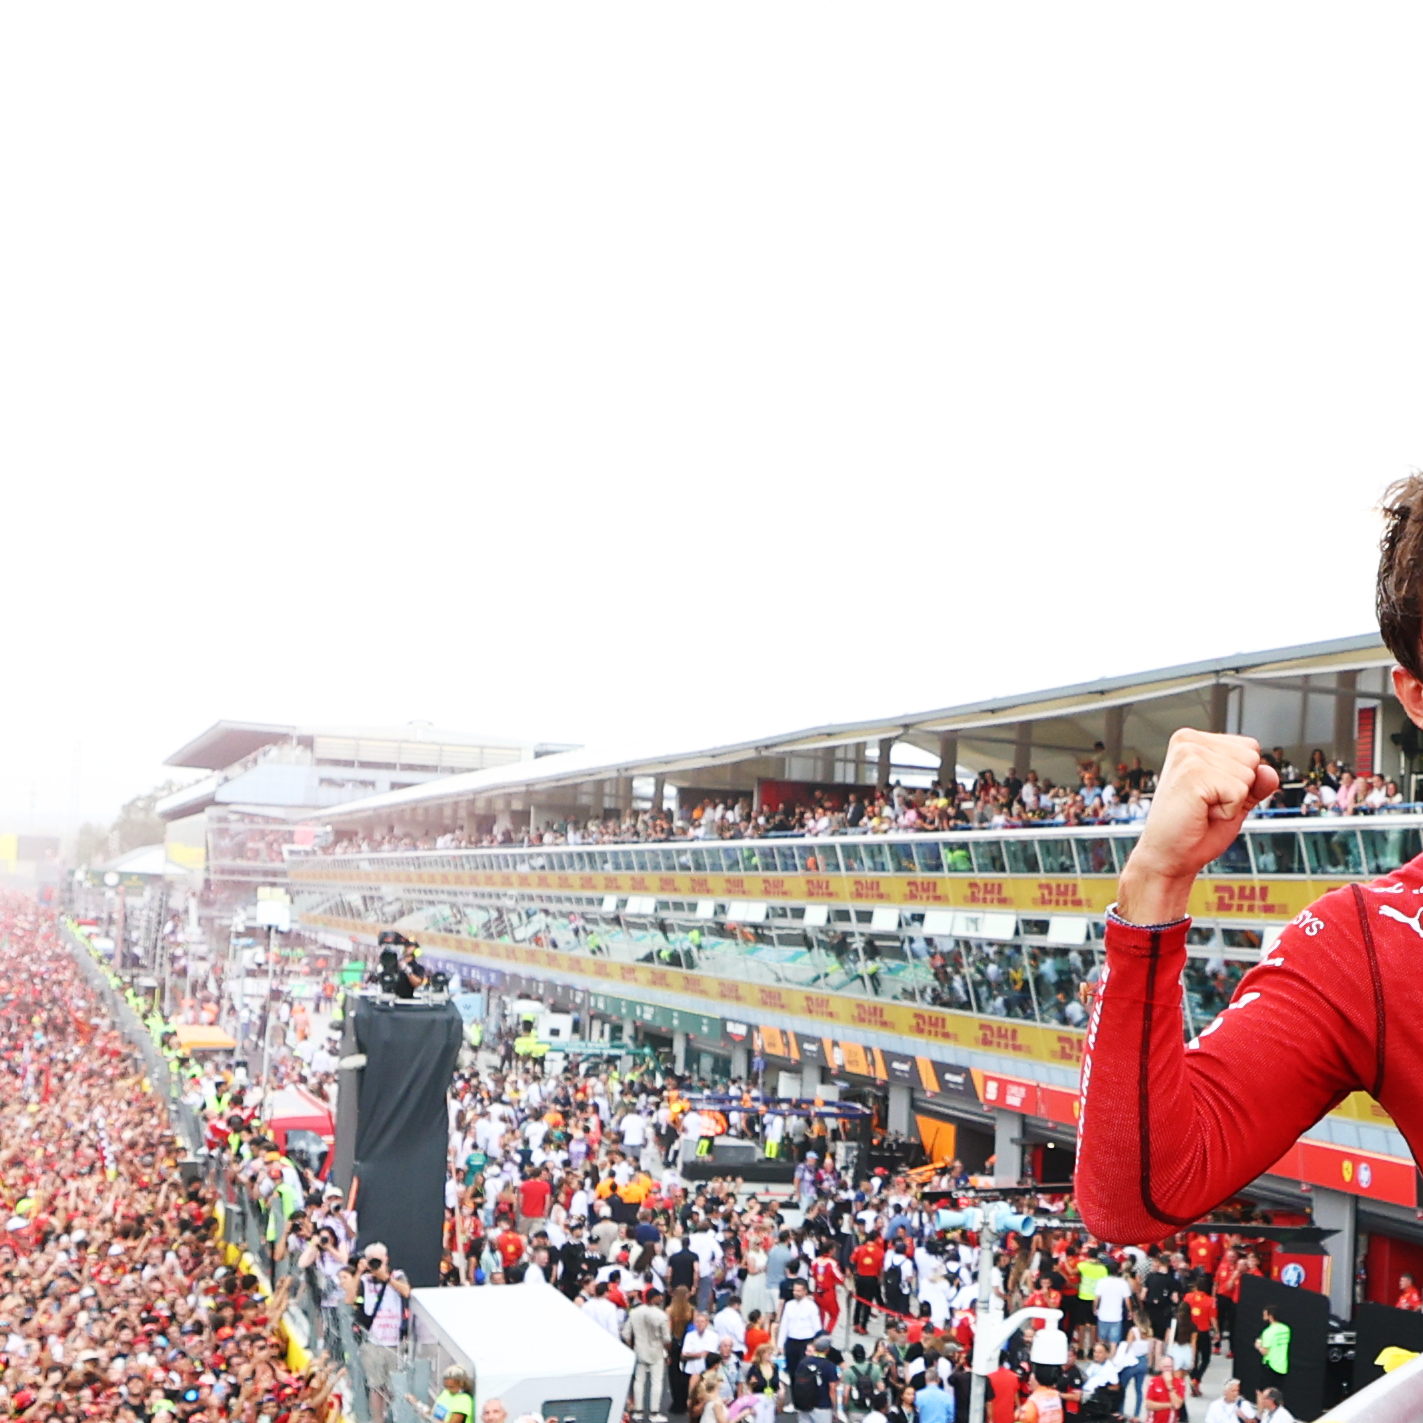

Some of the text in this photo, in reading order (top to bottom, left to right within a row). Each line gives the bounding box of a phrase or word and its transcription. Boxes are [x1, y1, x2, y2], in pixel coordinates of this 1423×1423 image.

[906, 881, 943, 901] DHL
[968, 882, 1011, 904] DHL
[1037, 883, 1085, 907] DHL
[1213, 884, 1279, 913] DHL
[912, 1012, 954, 1040] DHL
[978, 1023, 1025, 1051] DHL
